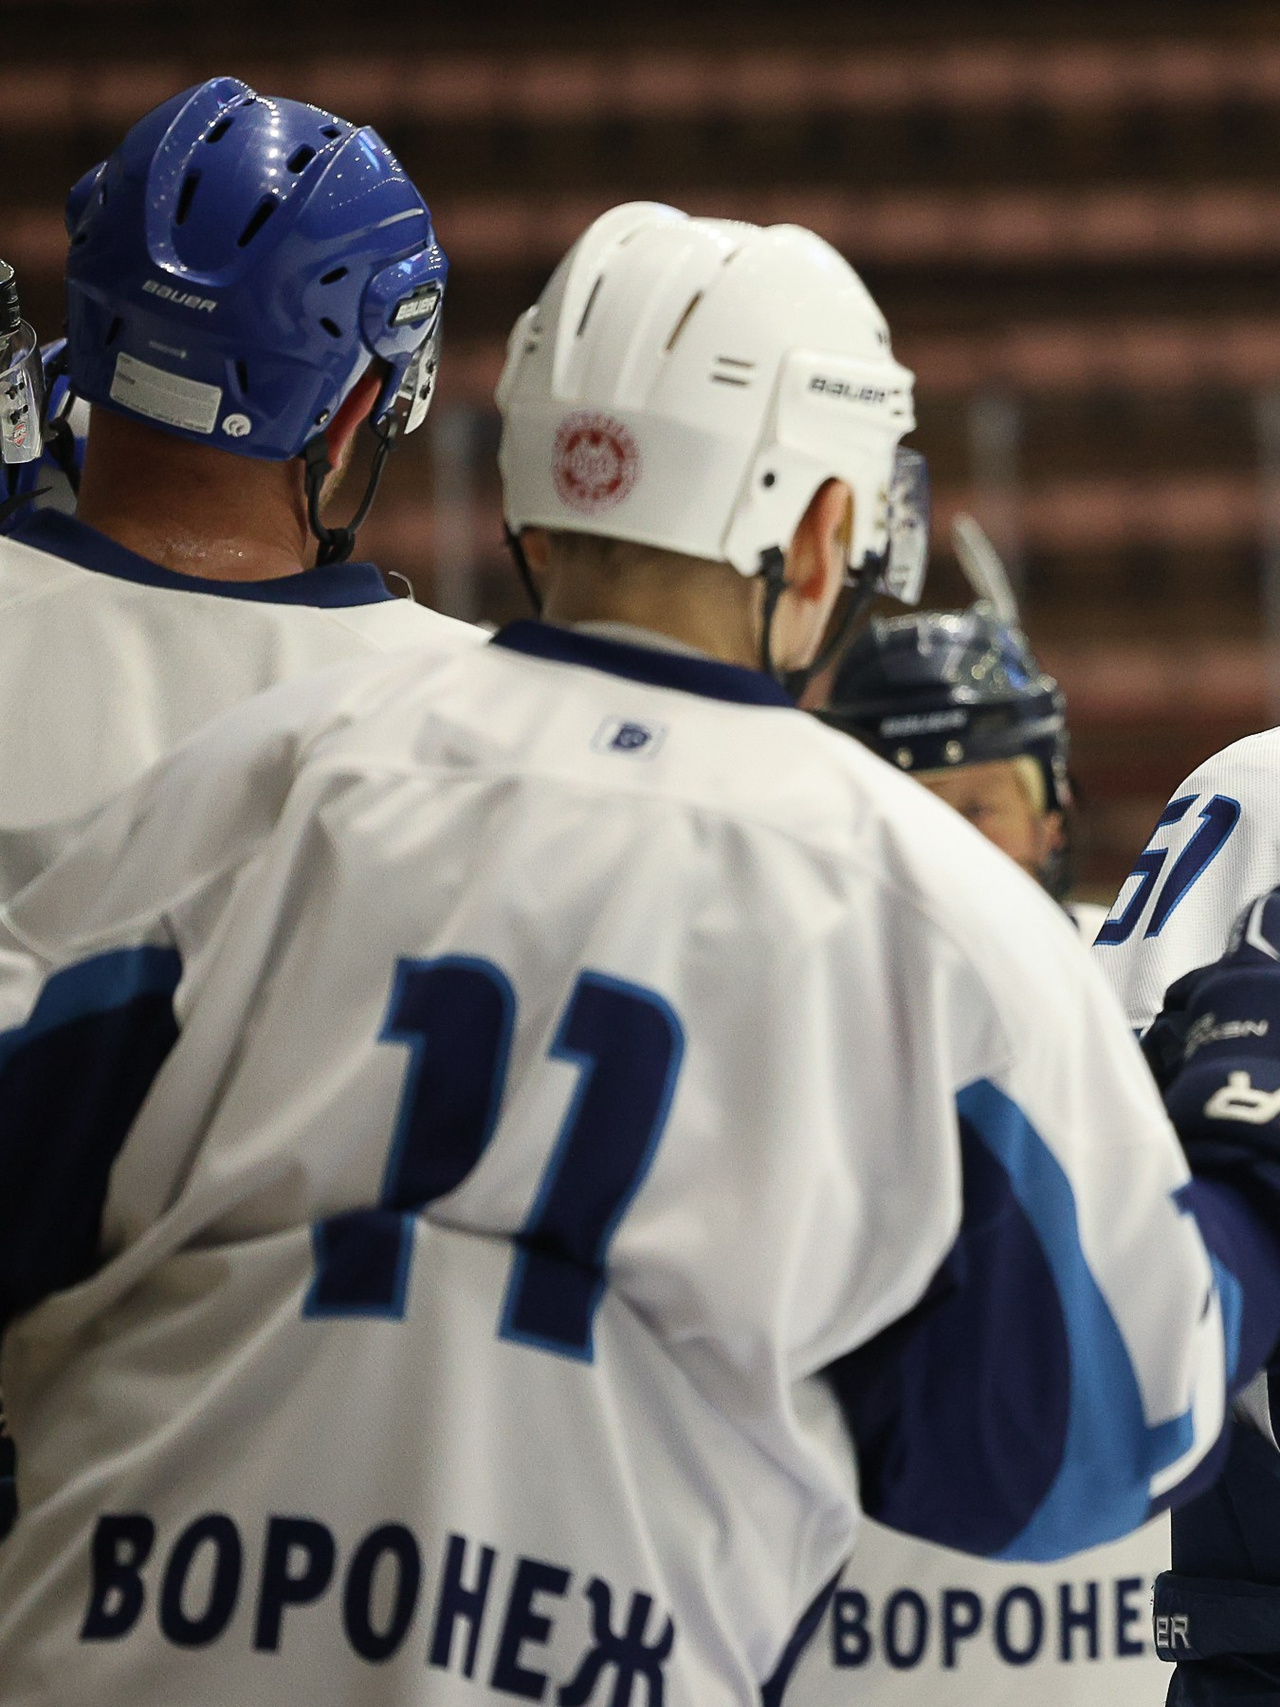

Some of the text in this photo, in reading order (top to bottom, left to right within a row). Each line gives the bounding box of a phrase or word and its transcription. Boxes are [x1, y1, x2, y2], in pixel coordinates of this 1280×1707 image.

[142, 279, 218, 314] BAUER
[395, 295, 437, 320] BAUER
[1092, 793, 1241, 946] 51
[302, 952, 685, 1363] 11
[78, 1510, 676, 1707] ВОРОНЕЖ
[832, 1575, 1152, 1671] ВОРОНЕ
